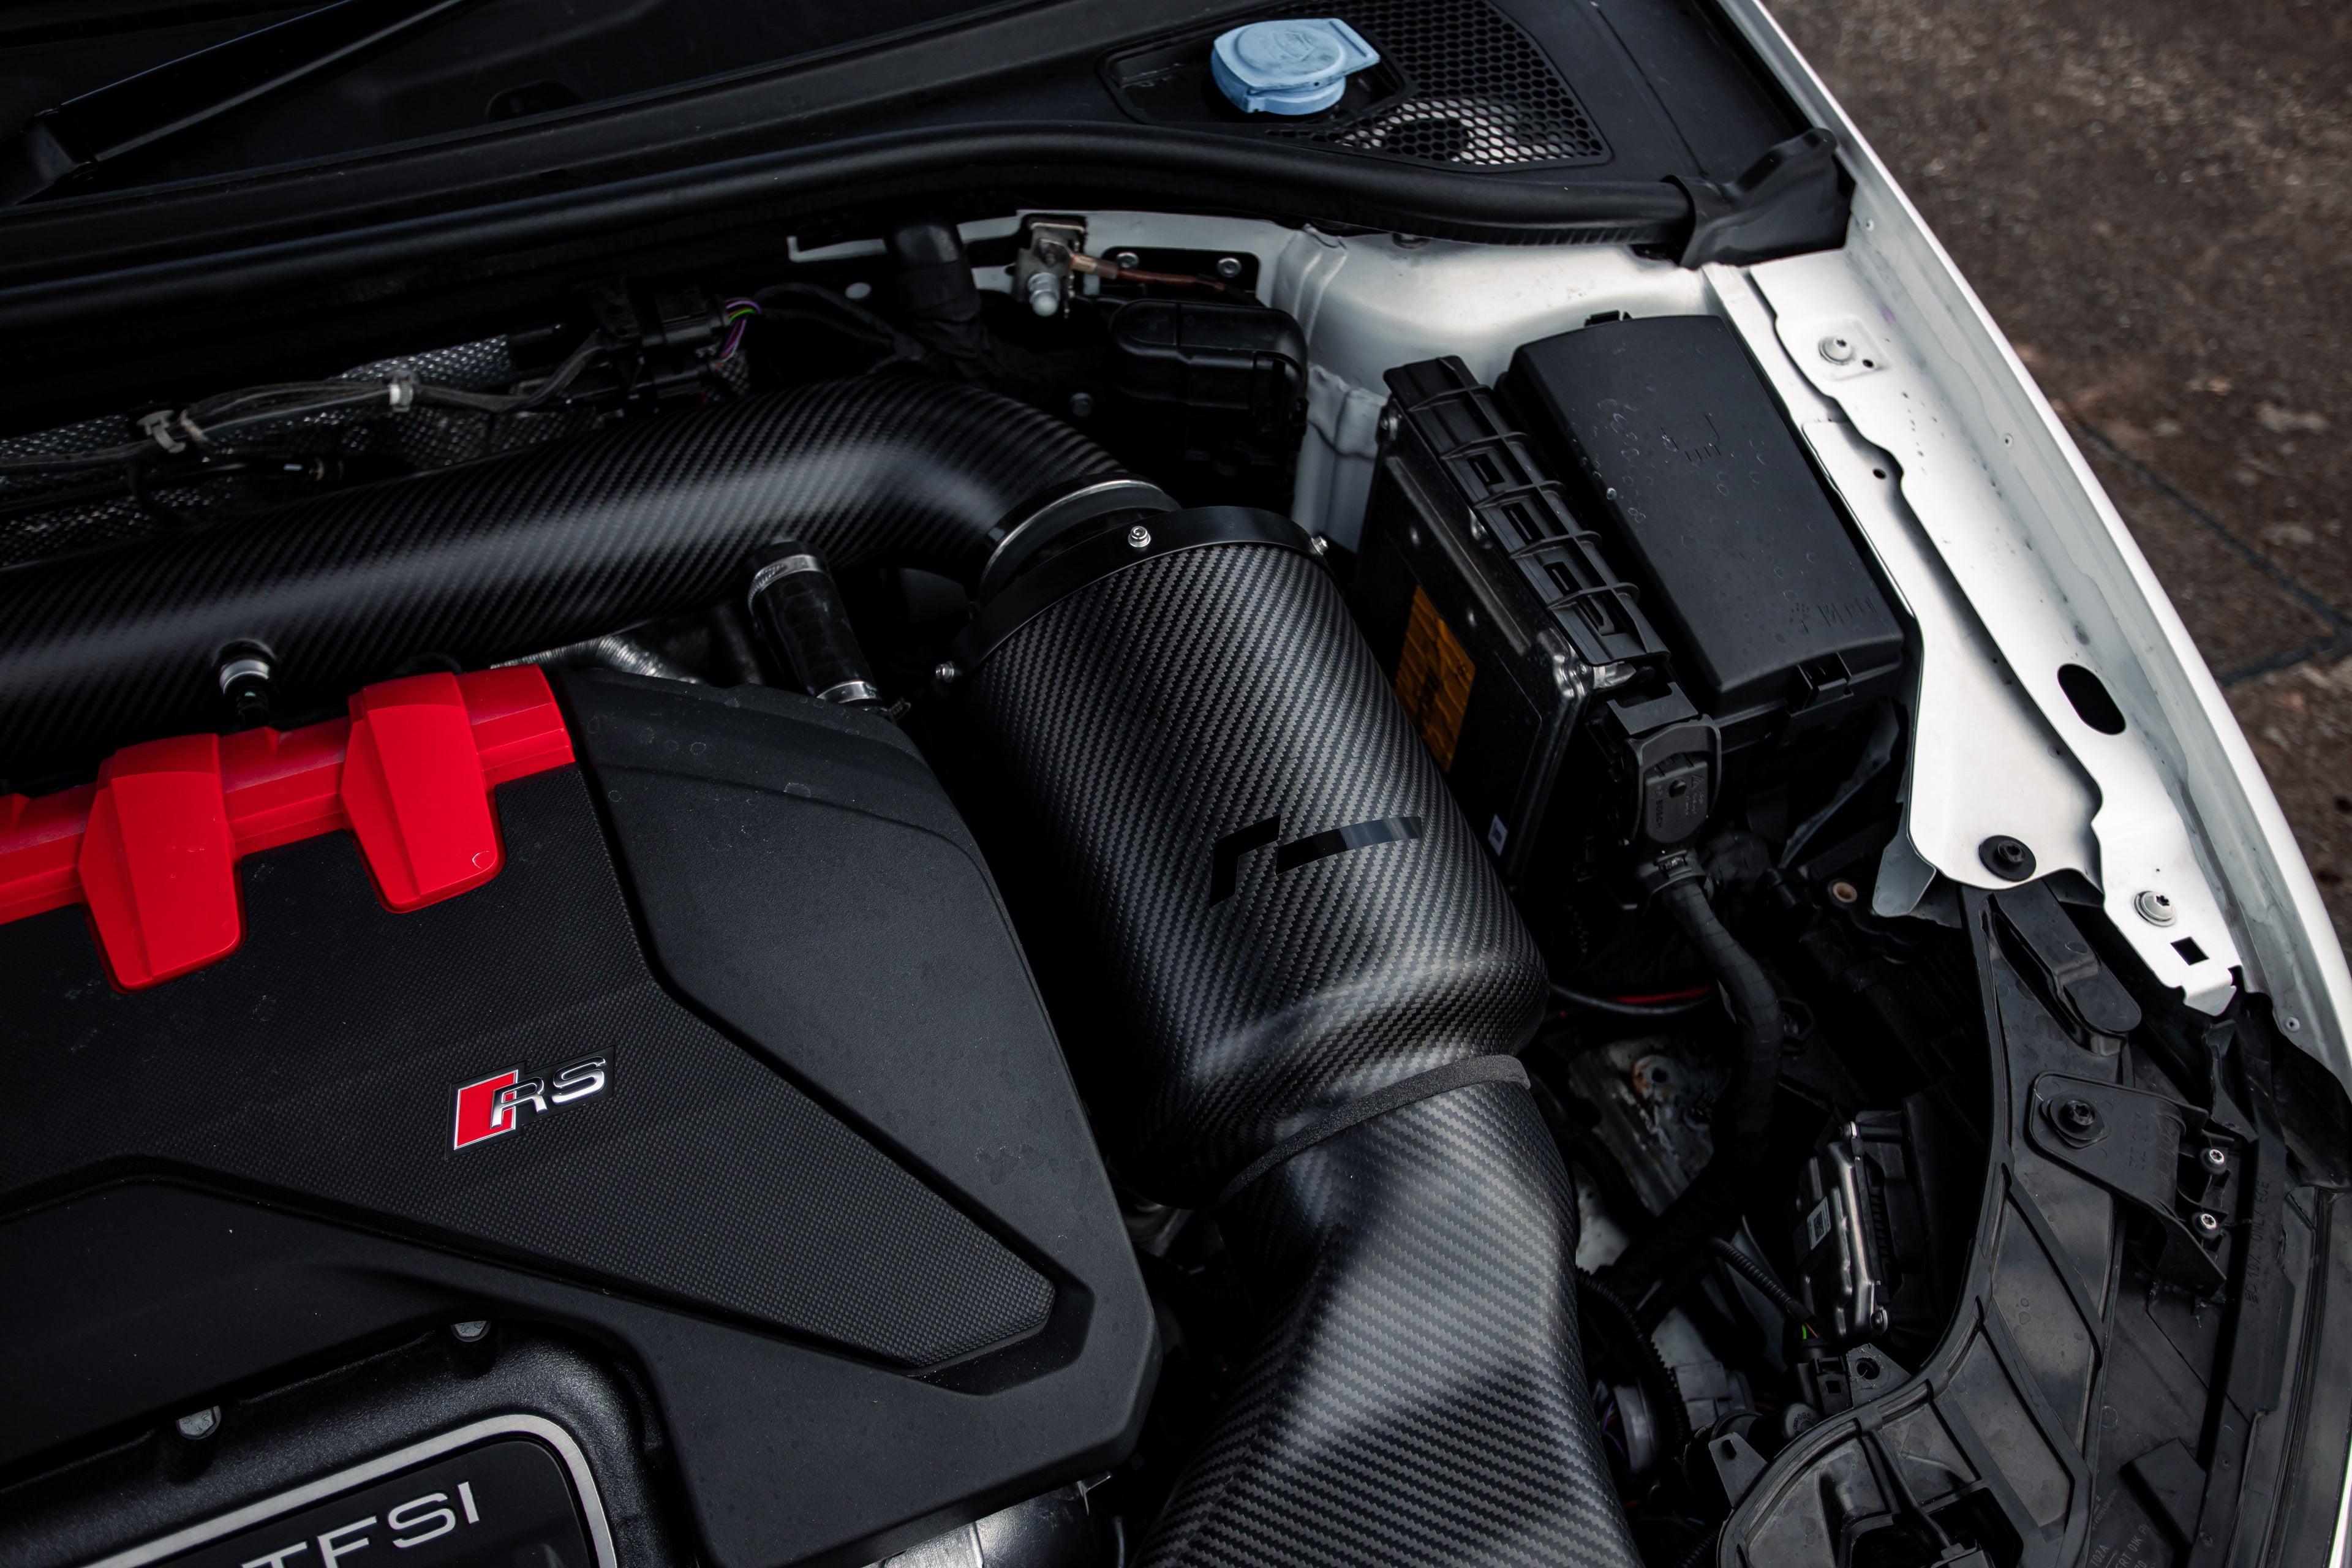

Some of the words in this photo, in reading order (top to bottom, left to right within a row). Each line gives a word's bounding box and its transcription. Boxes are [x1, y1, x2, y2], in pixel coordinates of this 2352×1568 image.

[489, 1055, 607, 1129] RS
[2250, 1208, 2266, 1241] ONLY
[239, 1479, 480, 1568] TFSI
